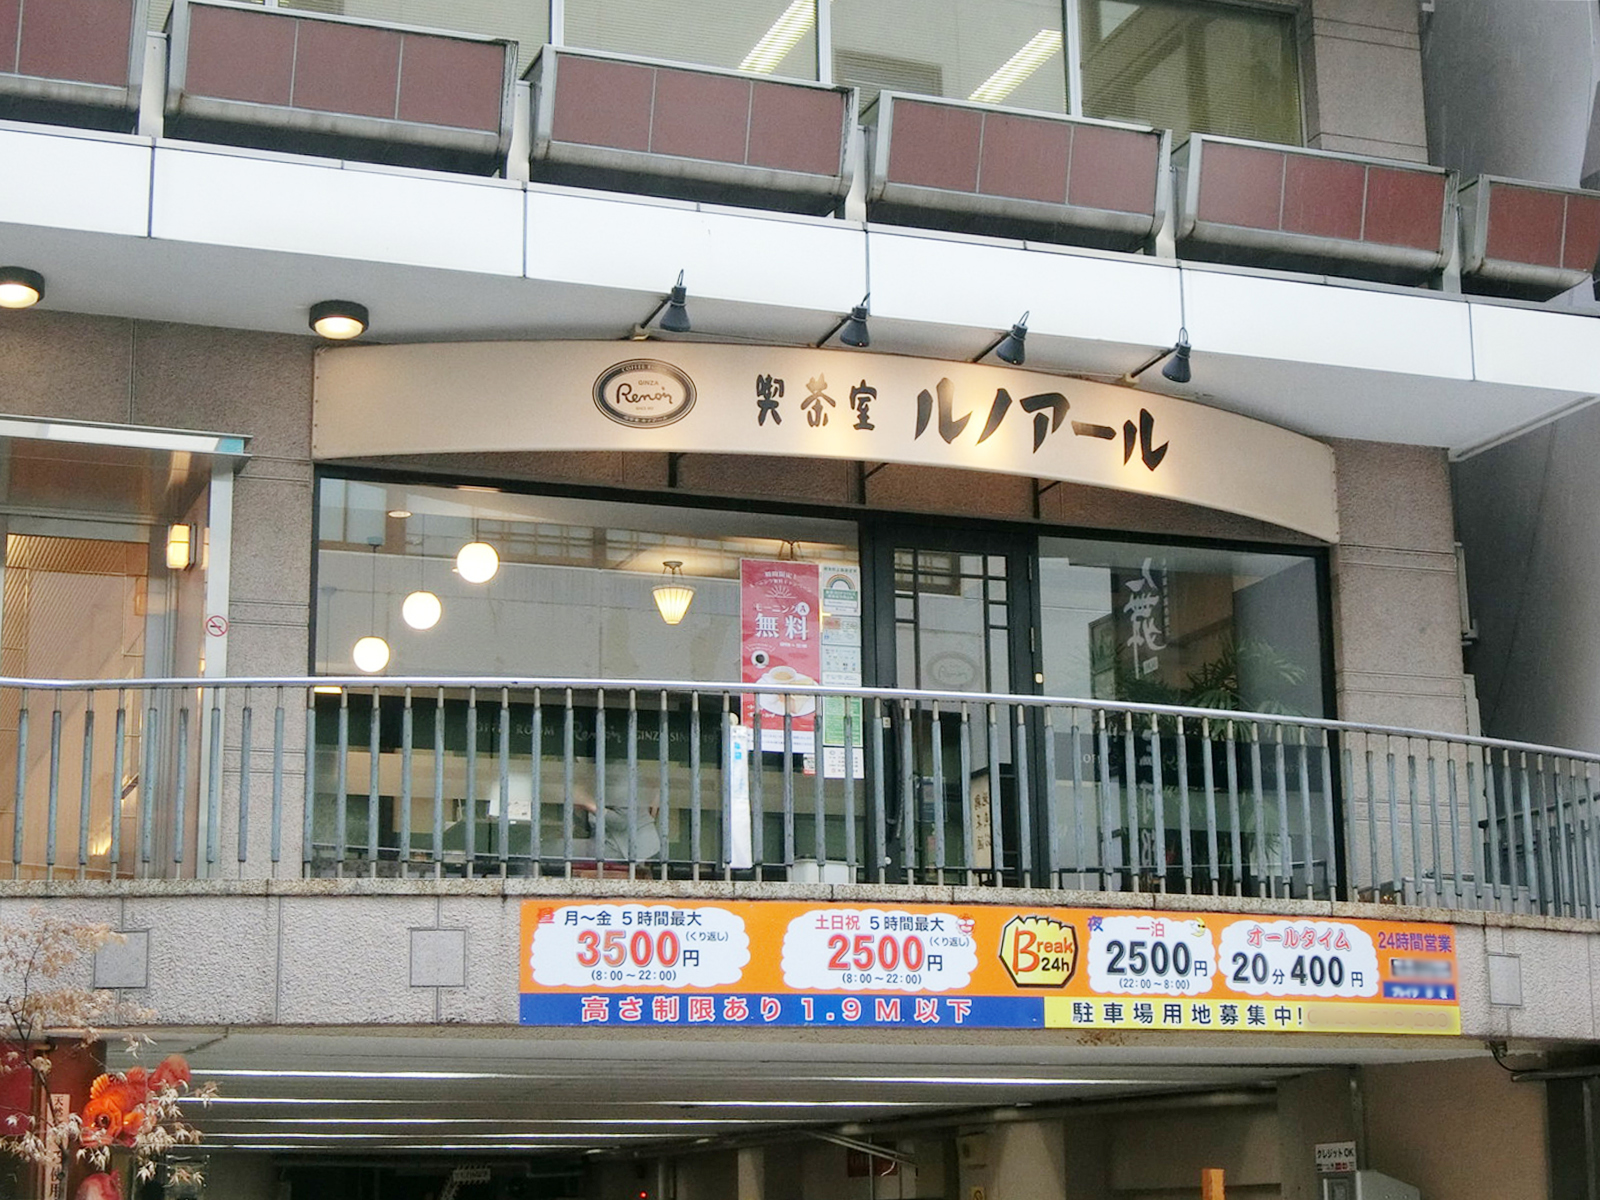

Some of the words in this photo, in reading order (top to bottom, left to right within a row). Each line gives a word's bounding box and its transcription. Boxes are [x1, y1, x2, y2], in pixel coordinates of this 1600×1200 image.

[756, 372, 877, 431] 喫茶室
[914, 377, 1169, 472] ルノアール
[755, 613, 809, 641] 無料
[815, 915, 860, 930] 土日祝
[1087, 916, 1103, 931] 夜
[1248, 928, 1351, 950] オールタイム
[1378, 932, 1452, 953] 24時間営業
[1012, 927, 1073, 975] Break
[1041, 957, 1070, 972] 24h
